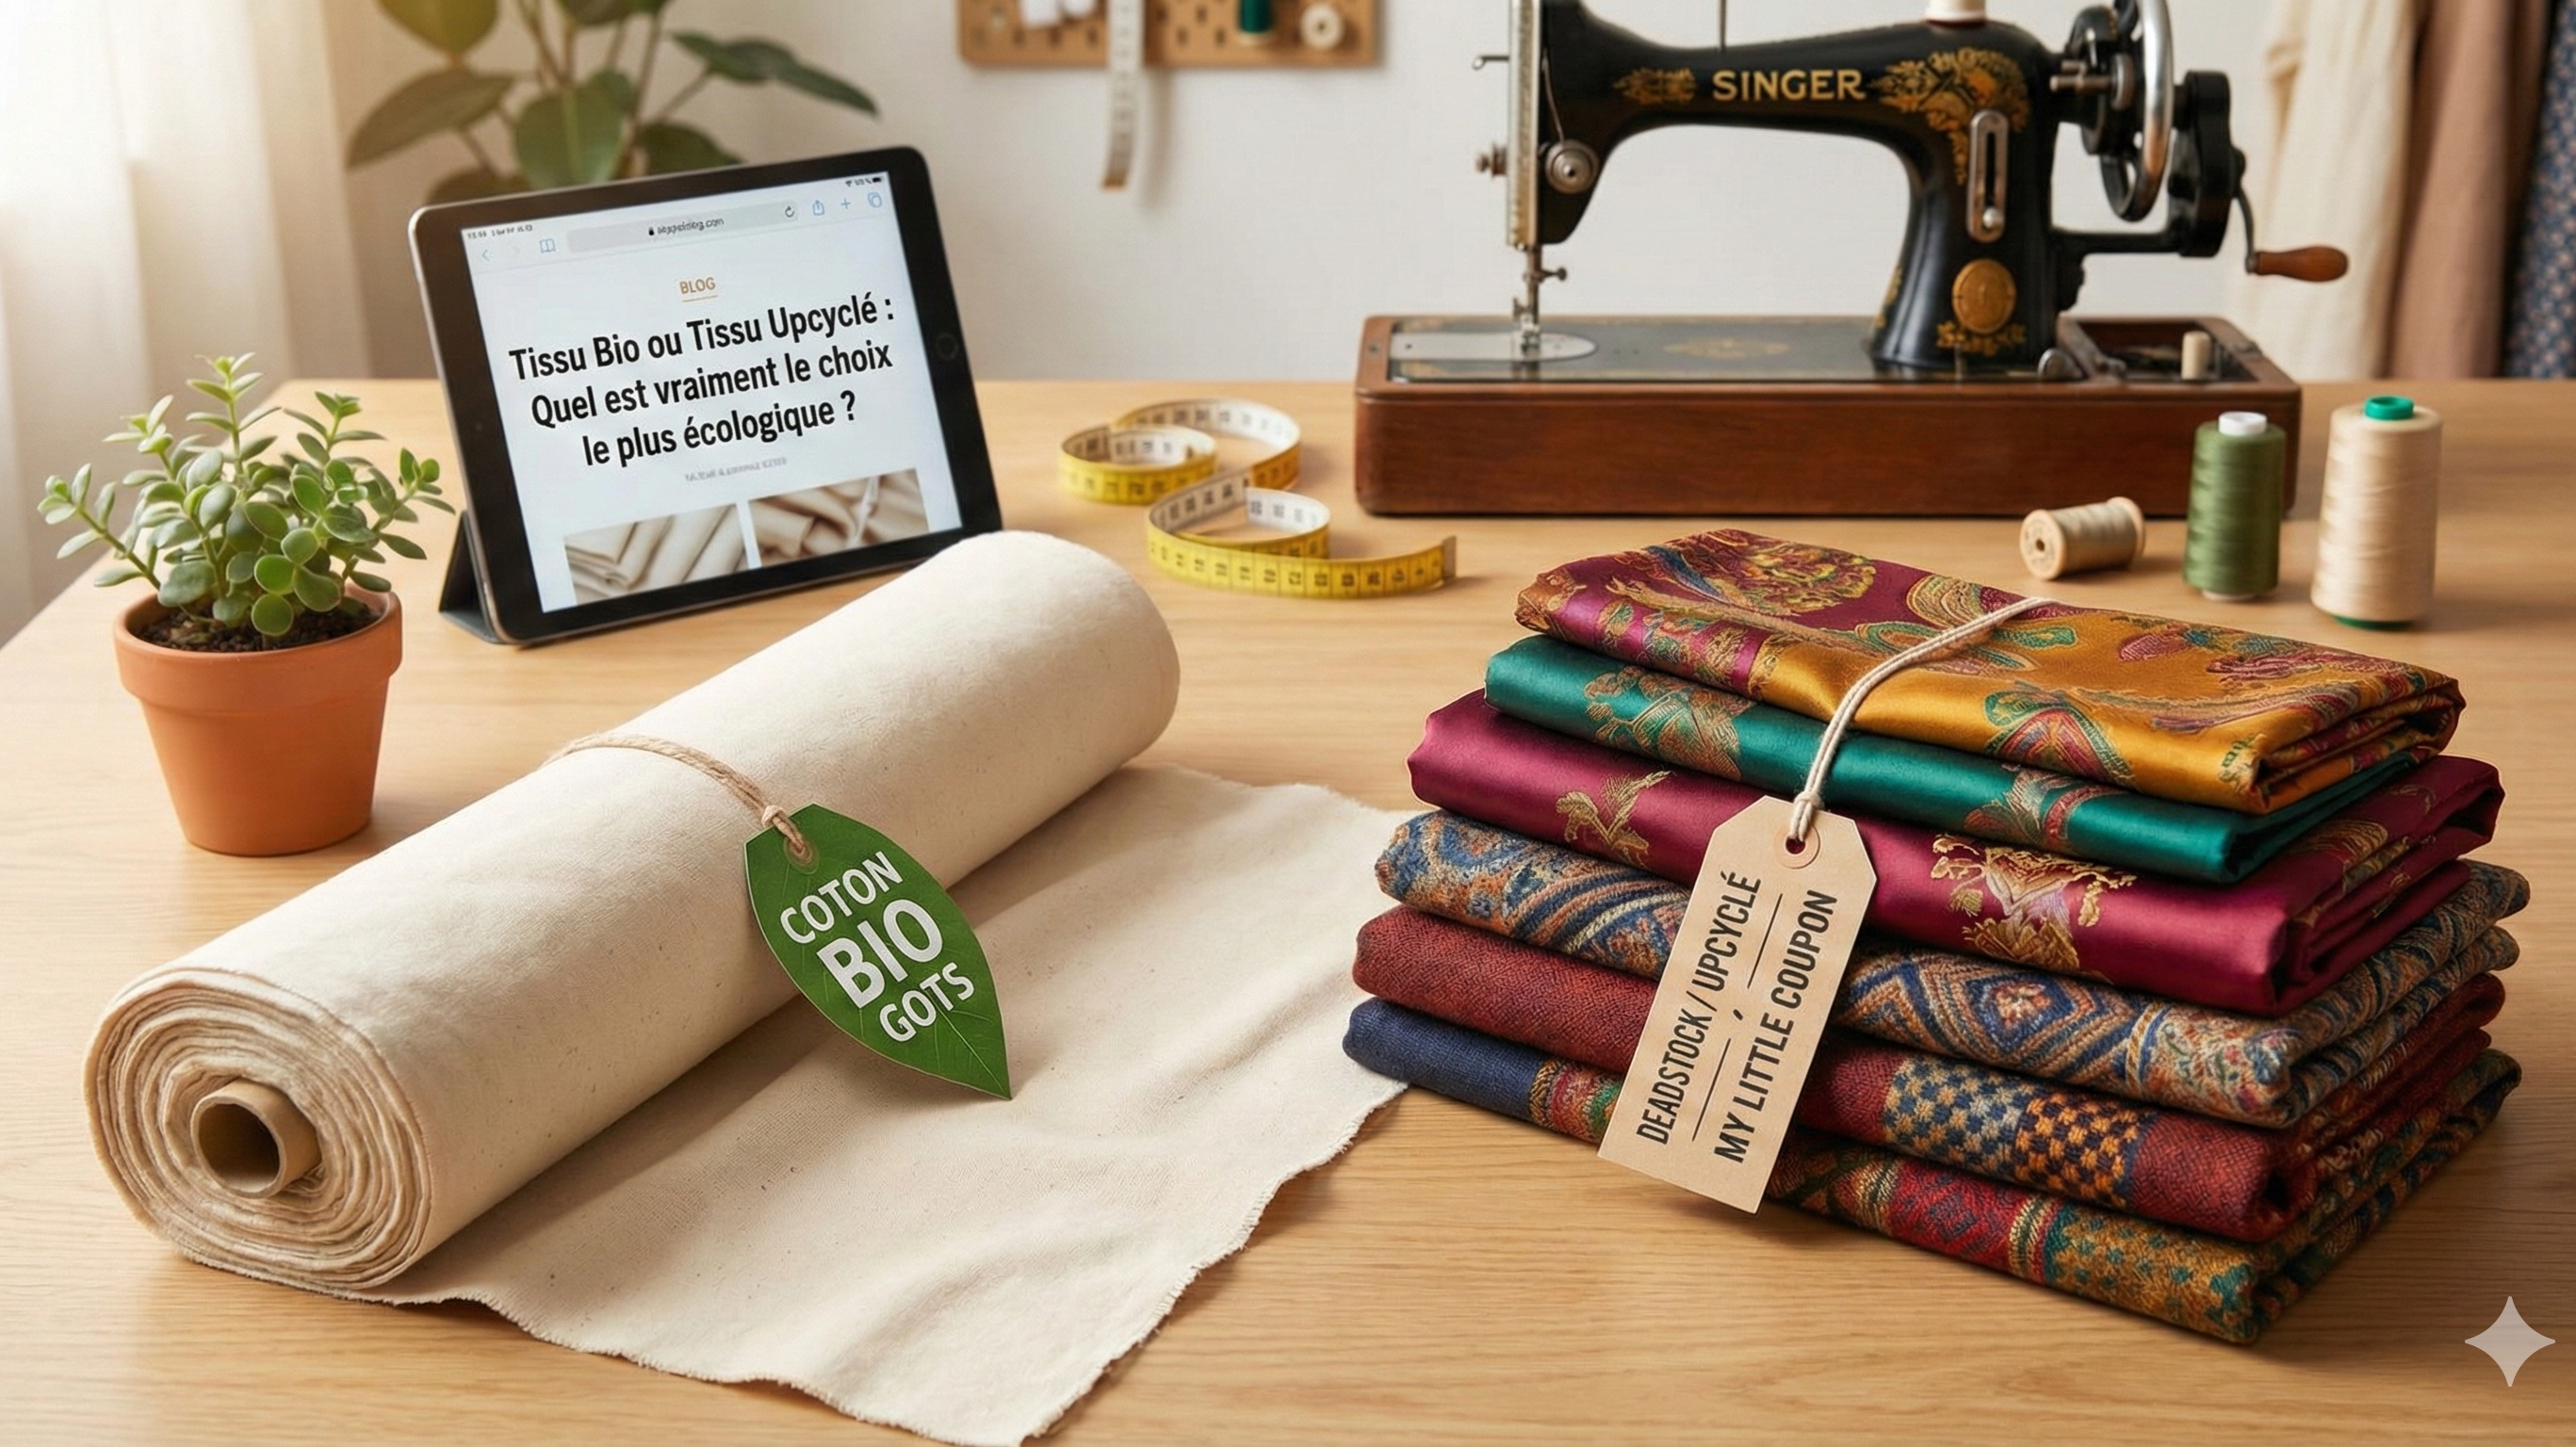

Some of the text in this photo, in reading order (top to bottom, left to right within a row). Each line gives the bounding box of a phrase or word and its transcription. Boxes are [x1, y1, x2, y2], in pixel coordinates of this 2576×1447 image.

[1711, 69, 1867, 102] SINGER
[678, 276, 717, 295] BLOG
[508, 291, 894, 381] Tissu Bio ou Tissu Upcyclé :
[531, 339, 893, 430] Quel est vraiment le choix
[582, 389, 856, 468] le plus écologique ?
[780, 851, 904, 944] COTON
[816, 899, 943, 1009] BIO
[879, 962, 975, 1042] GOTS
[1636, 870, 1762, 1146] DEADSTOCK / UPCYCLÉ
[1713, 889, 1838, 1164] MY LITTLE COUPON
